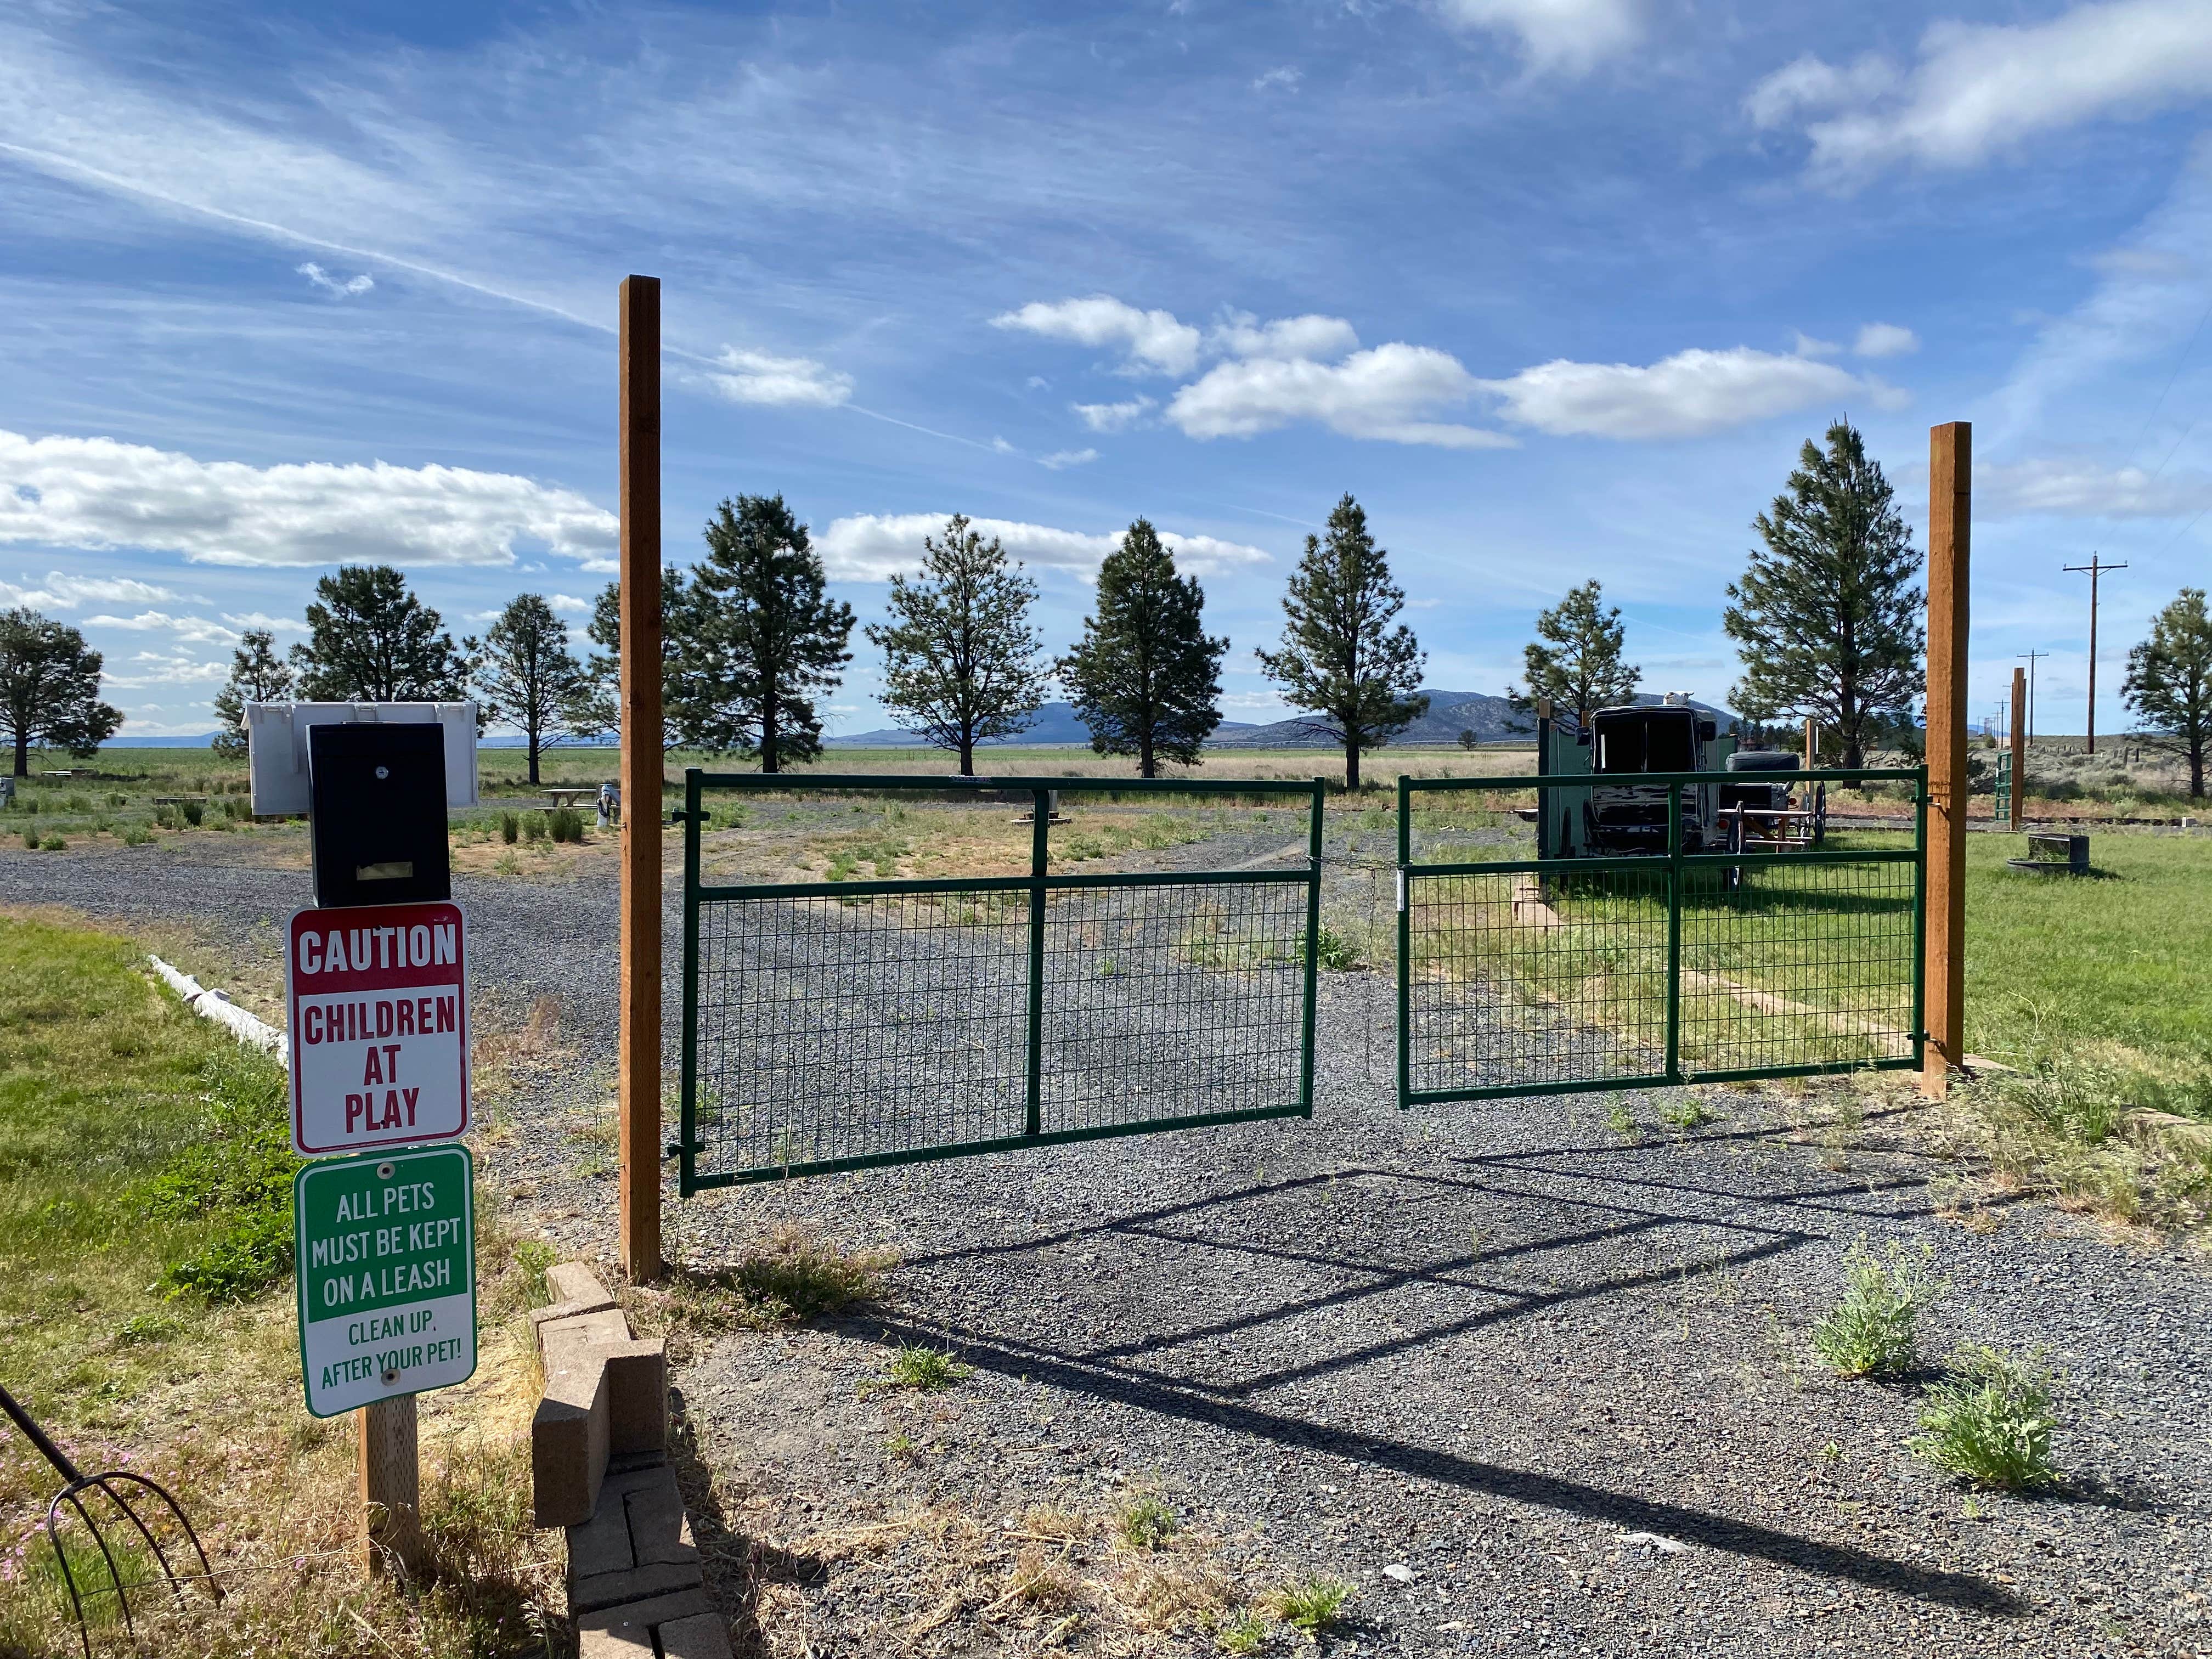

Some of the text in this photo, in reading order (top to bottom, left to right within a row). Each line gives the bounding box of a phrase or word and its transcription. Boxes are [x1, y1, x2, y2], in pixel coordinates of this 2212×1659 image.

[299, 924, 456, 974] CAUTION
[304, 996, 455, 1045] CHILDREN
[363, 1044, 401, 1086] AT
[345, 1087, 420, 1133] PLAY
[336, 1182, 435, 1223] ALL PETS
[312, 1217, 461, 1268] MUST BE KEPT
[323, 1259, 450, 1307] ON A LEASH
[348, 1314, 404, 1346] CLEAN
[321, 1338, 461, 1390] AFTER YOUR PET!
